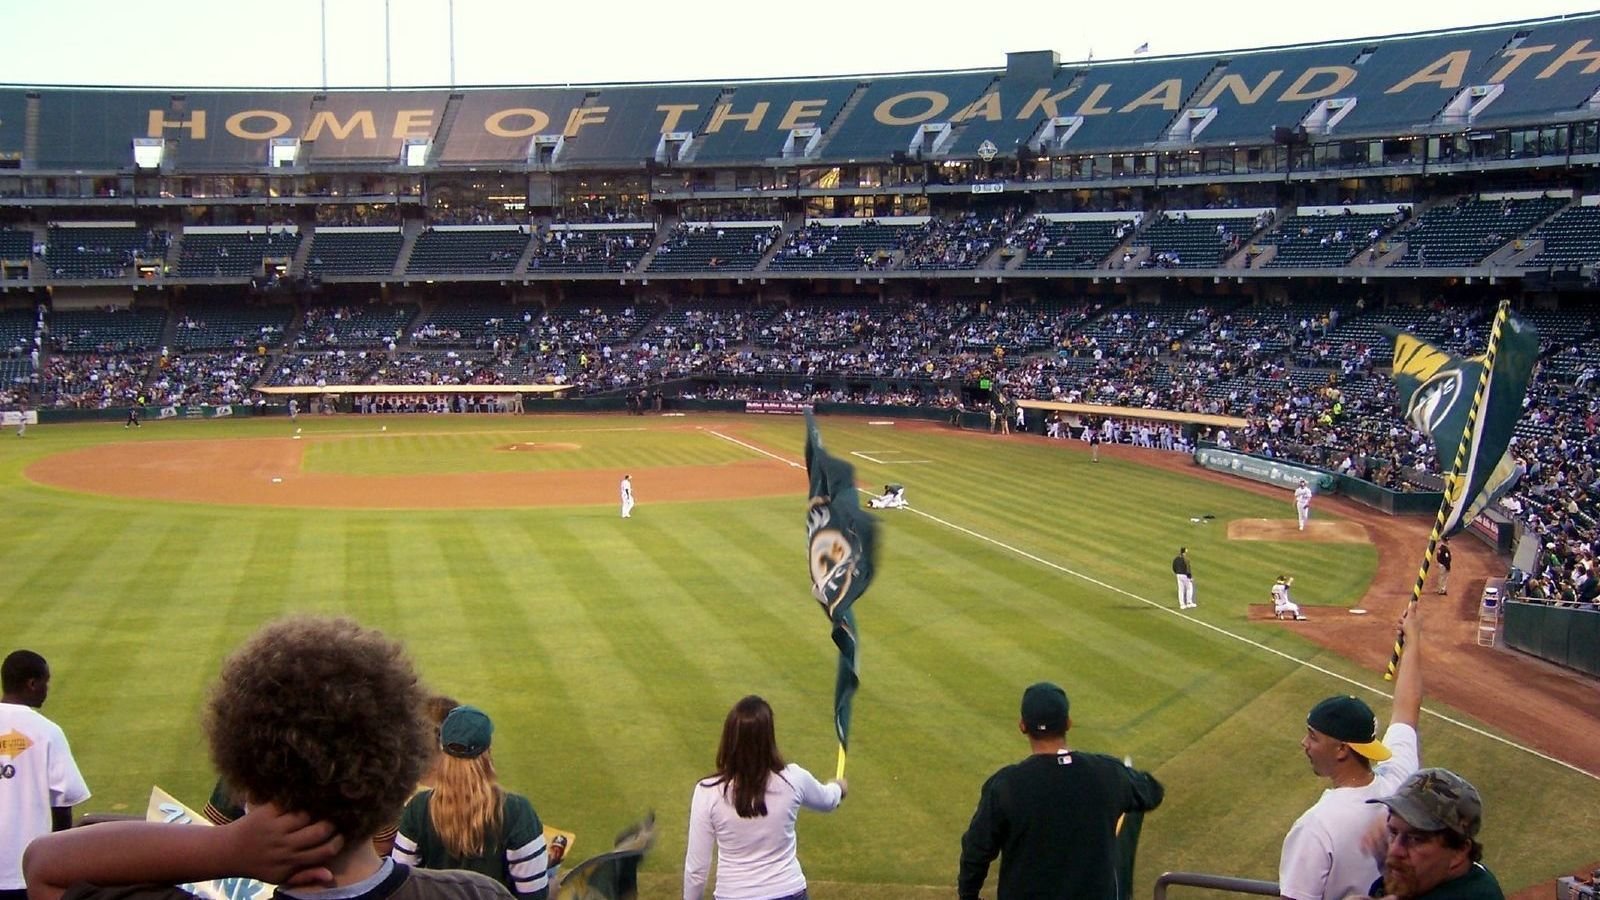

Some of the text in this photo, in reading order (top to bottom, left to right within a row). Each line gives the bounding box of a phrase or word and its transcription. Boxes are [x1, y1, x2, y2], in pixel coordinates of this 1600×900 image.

[148, 39, 1600, 140] HOME OF THE OAKLAND ATH
